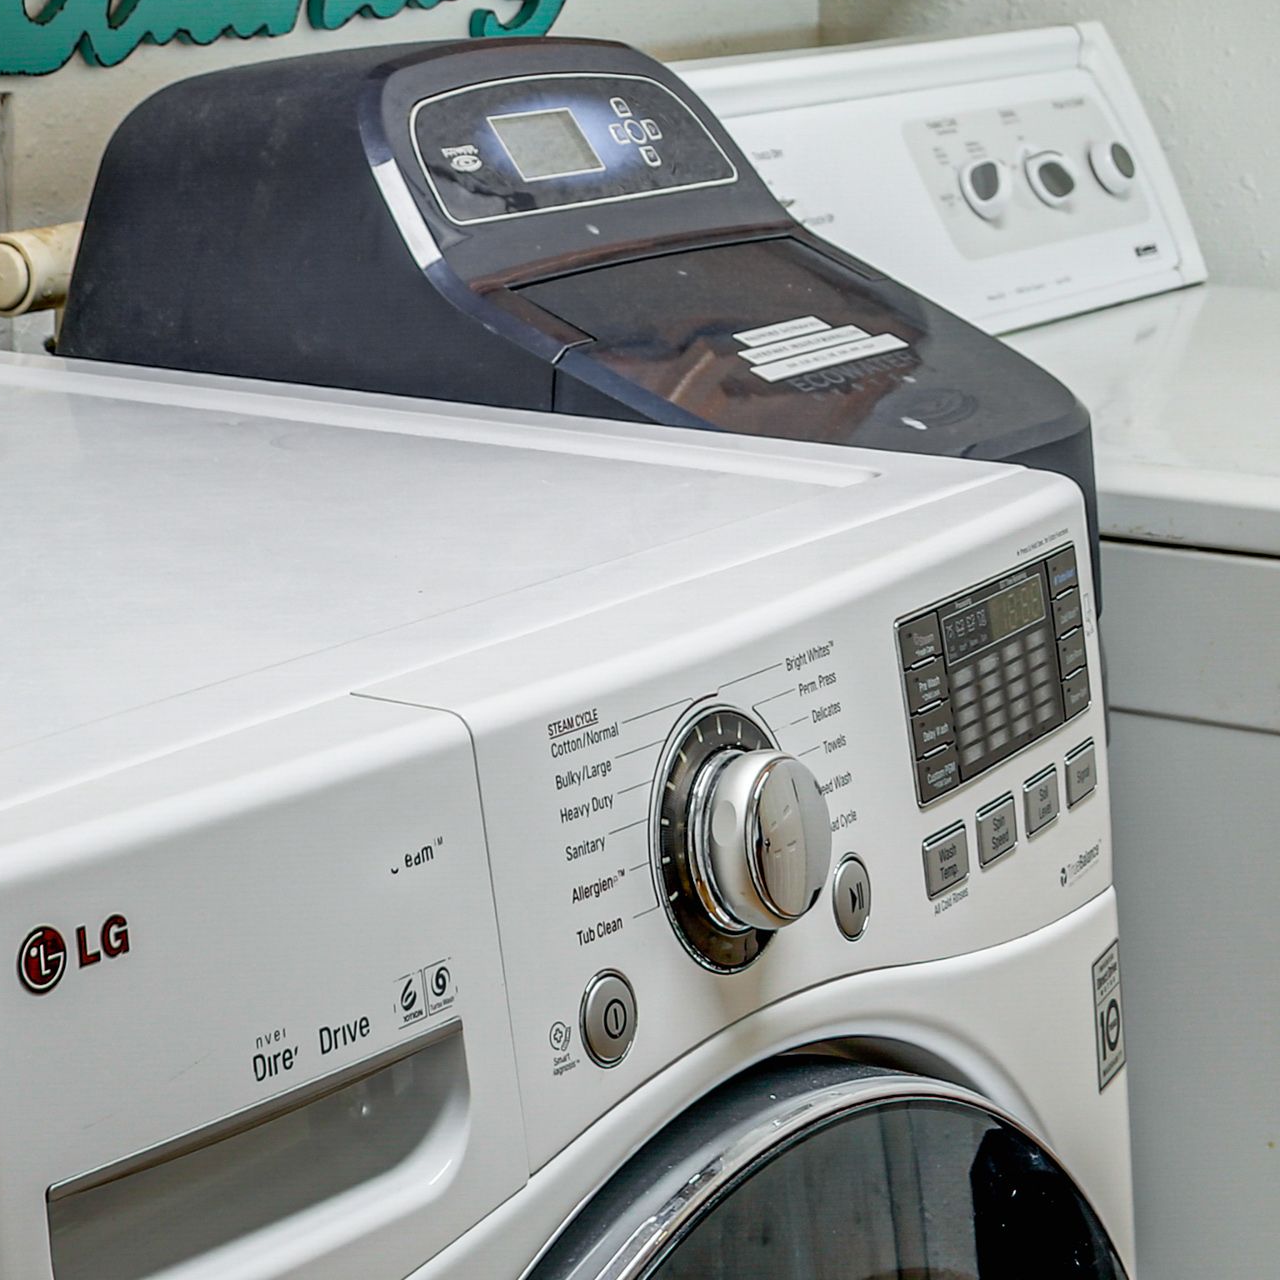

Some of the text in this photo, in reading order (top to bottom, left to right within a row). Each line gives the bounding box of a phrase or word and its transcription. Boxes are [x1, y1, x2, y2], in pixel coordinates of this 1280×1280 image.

[785, 653, 807, 672] Bright
[818, 672, 837, 689] Press
[547, 708, 599, 737] STEAM CYCLE
[812, 702, 841, 724] Delicates
[550, 721, 619, 759] Cotton/Normal
[823, 733, 847, 754] Towels
[555, 760, 612, 791] Bulky/Large
[560, 794, 614, 824] Heavy Duty
[565, 836, 605, 862] Sanitary
[938, 843, 958, 863] Wash
[75, 914, 130, 969] LG
[576, 917, 623, 946] Tub Clean
[319, 1016, 371, 1056] Drive
